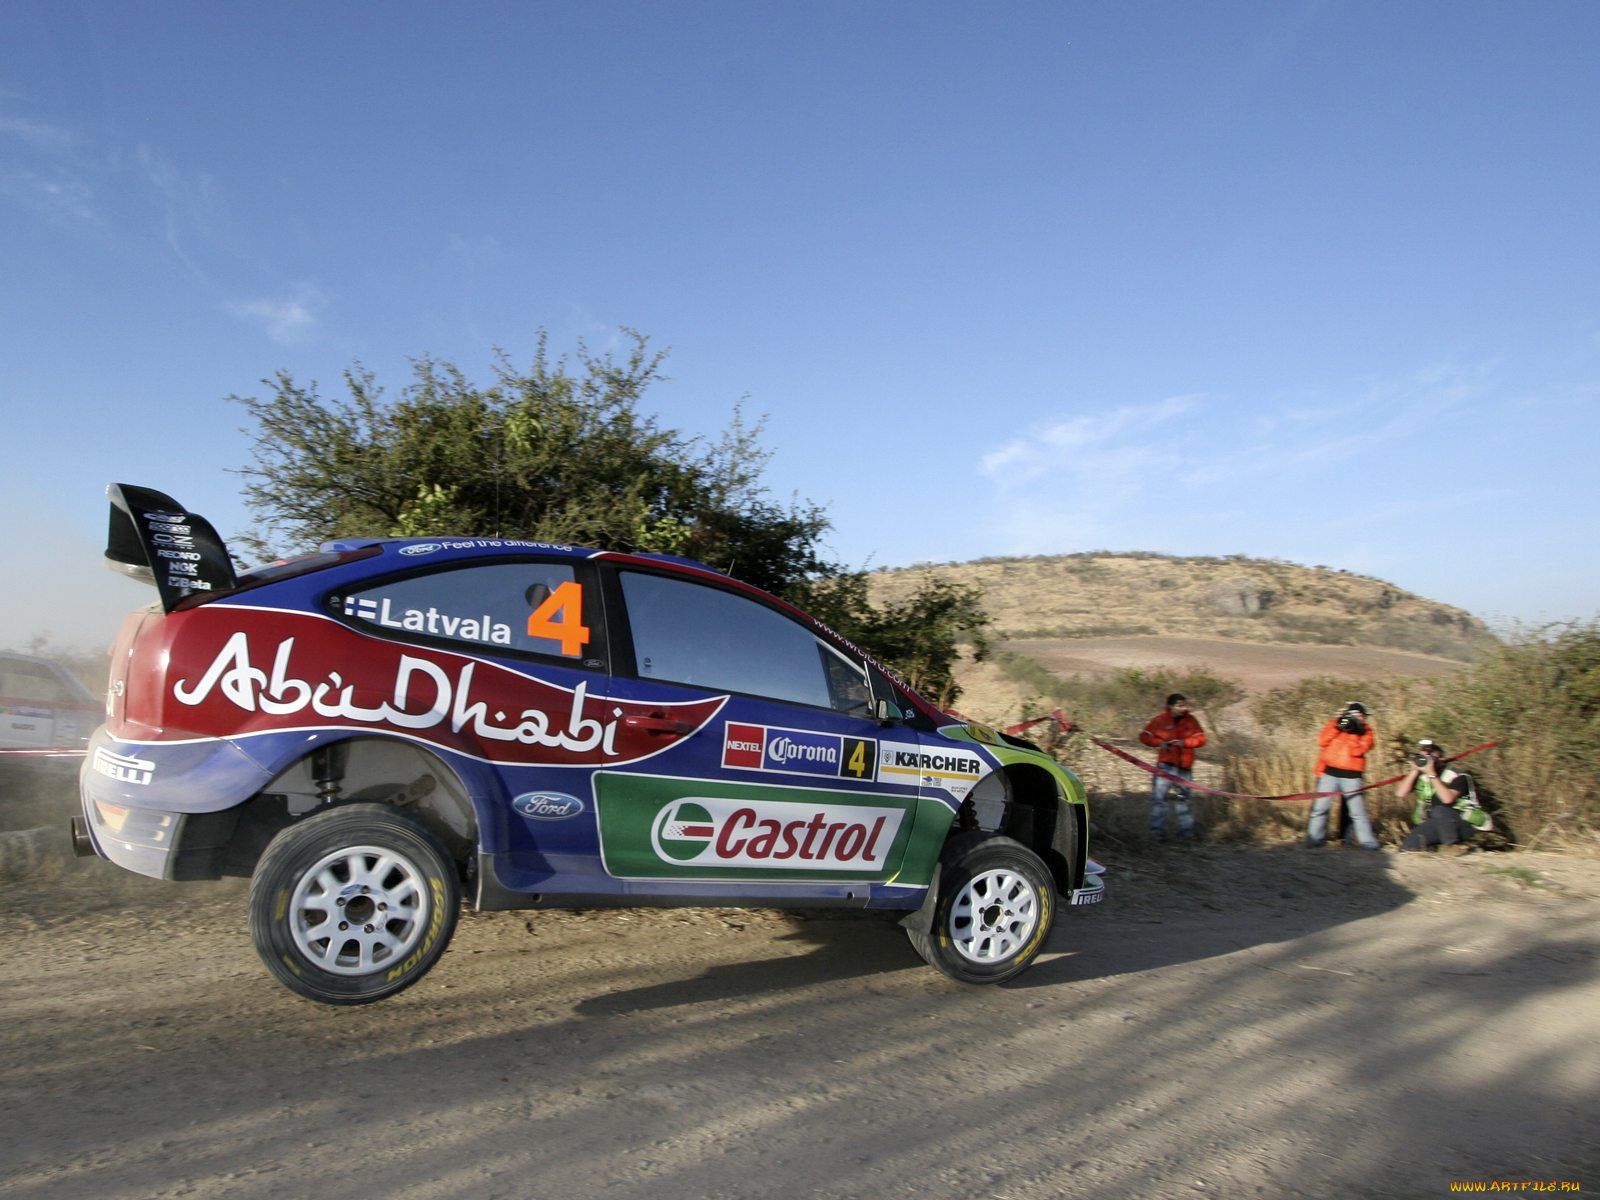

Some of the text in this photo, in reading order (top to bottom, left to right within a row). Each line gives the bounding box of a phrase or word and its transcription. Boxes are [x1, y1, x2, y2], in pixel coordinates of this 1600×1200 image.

[157, 549, 202, 561] RECARO
[442, 541, 475, 550] Feel
[477, 540, 502, 548] the
[504, 540, 573, 552] difference
[169, 561, 198, 573] NGK
[180, 576, 212, 591] Beta
[380, 598, 511, 645] Latvala
[527, 581, 590, 657] 4
[173, 632, 619, 756] Abu Dhabi
[727, 740, 762, 753] NEXTEL
[768, 737, 837, 765] Corona
[848, 741, 866, 778] 4
[895, 751, 981, 774] KÄRCHER
[524, 794, 572, 817] Ford
[715, 808, 887, 861] Castrol
